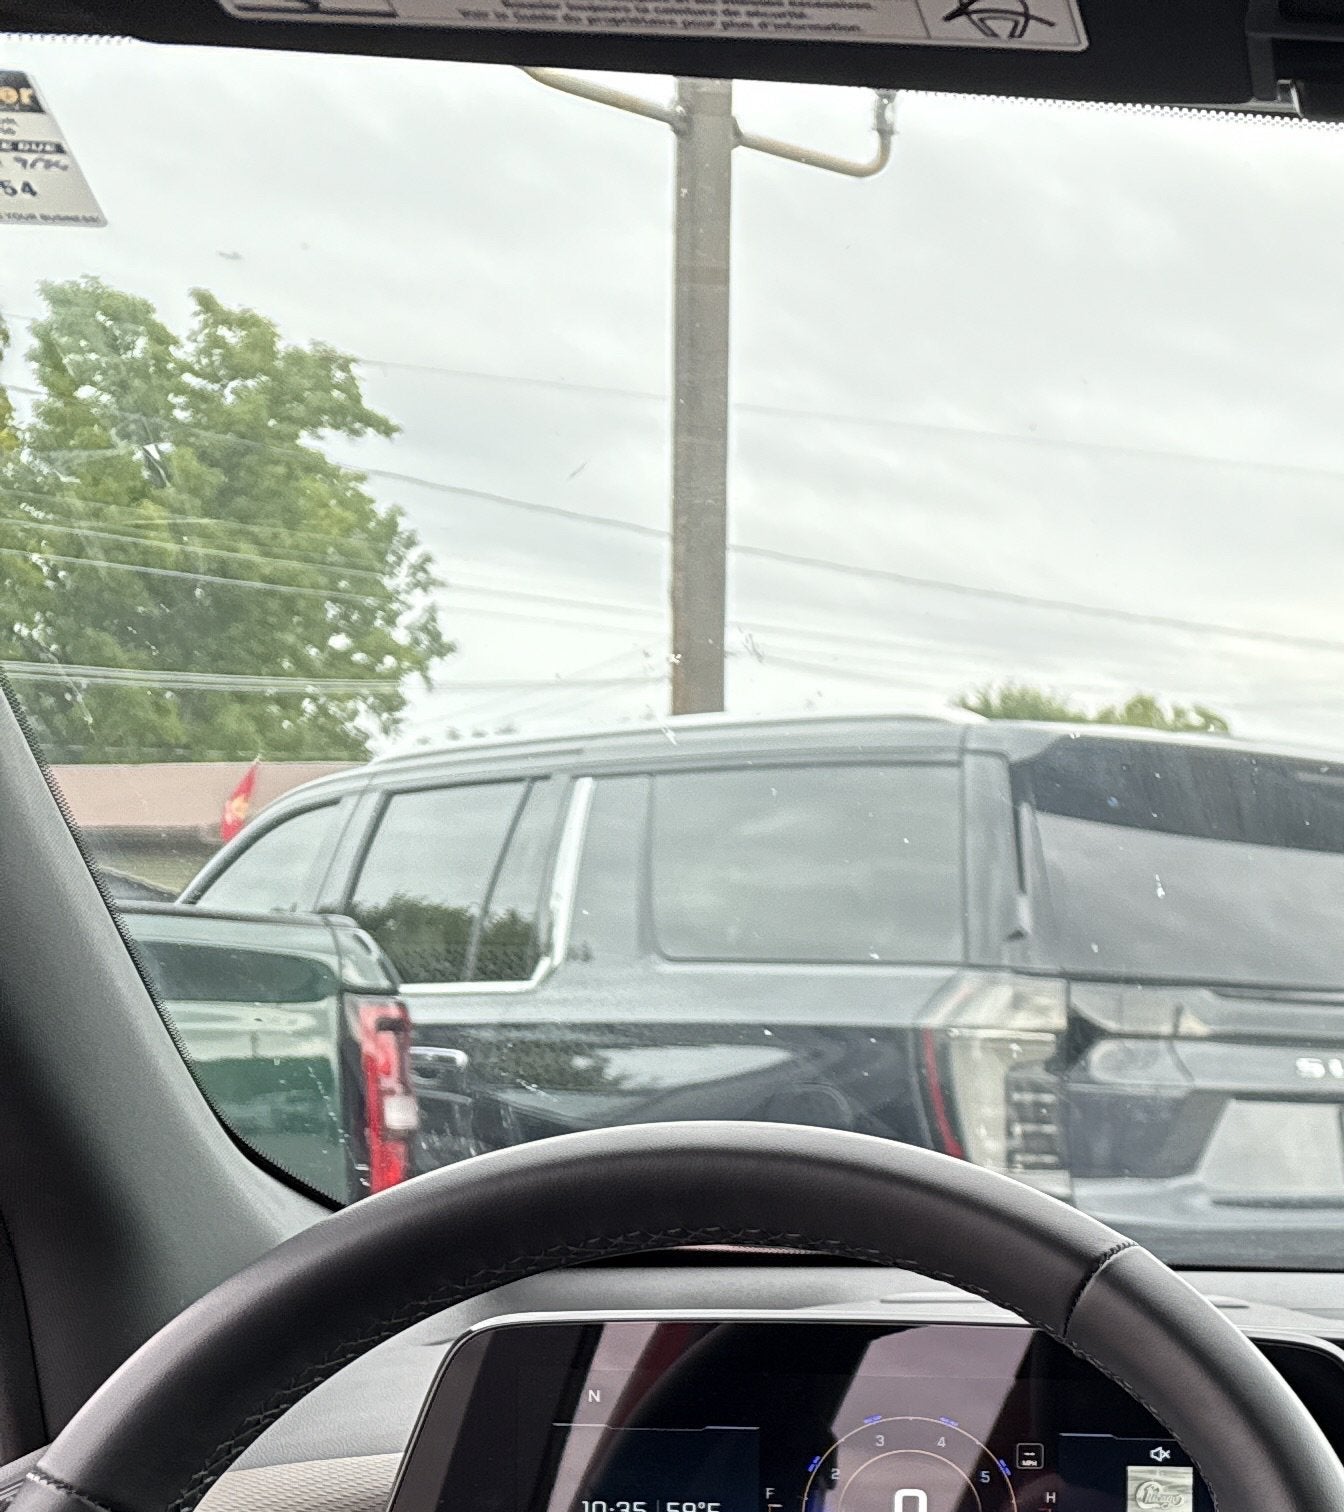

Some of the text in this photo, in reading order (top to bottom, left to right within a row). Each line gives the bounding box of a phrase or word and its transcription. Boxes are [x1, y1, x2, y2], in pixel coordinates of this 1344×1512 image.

[588, 1390, 601, 1403] N
[875, 1435, 885, 1448] 3
[936, 1436, 946, 1448] 4
[831, 1468, 841, 1481] 2
[980, 1471, 990, 1483] 5
[765, 1488, 775, 1500] F
[1046, 1492, 1057, 1504] H
